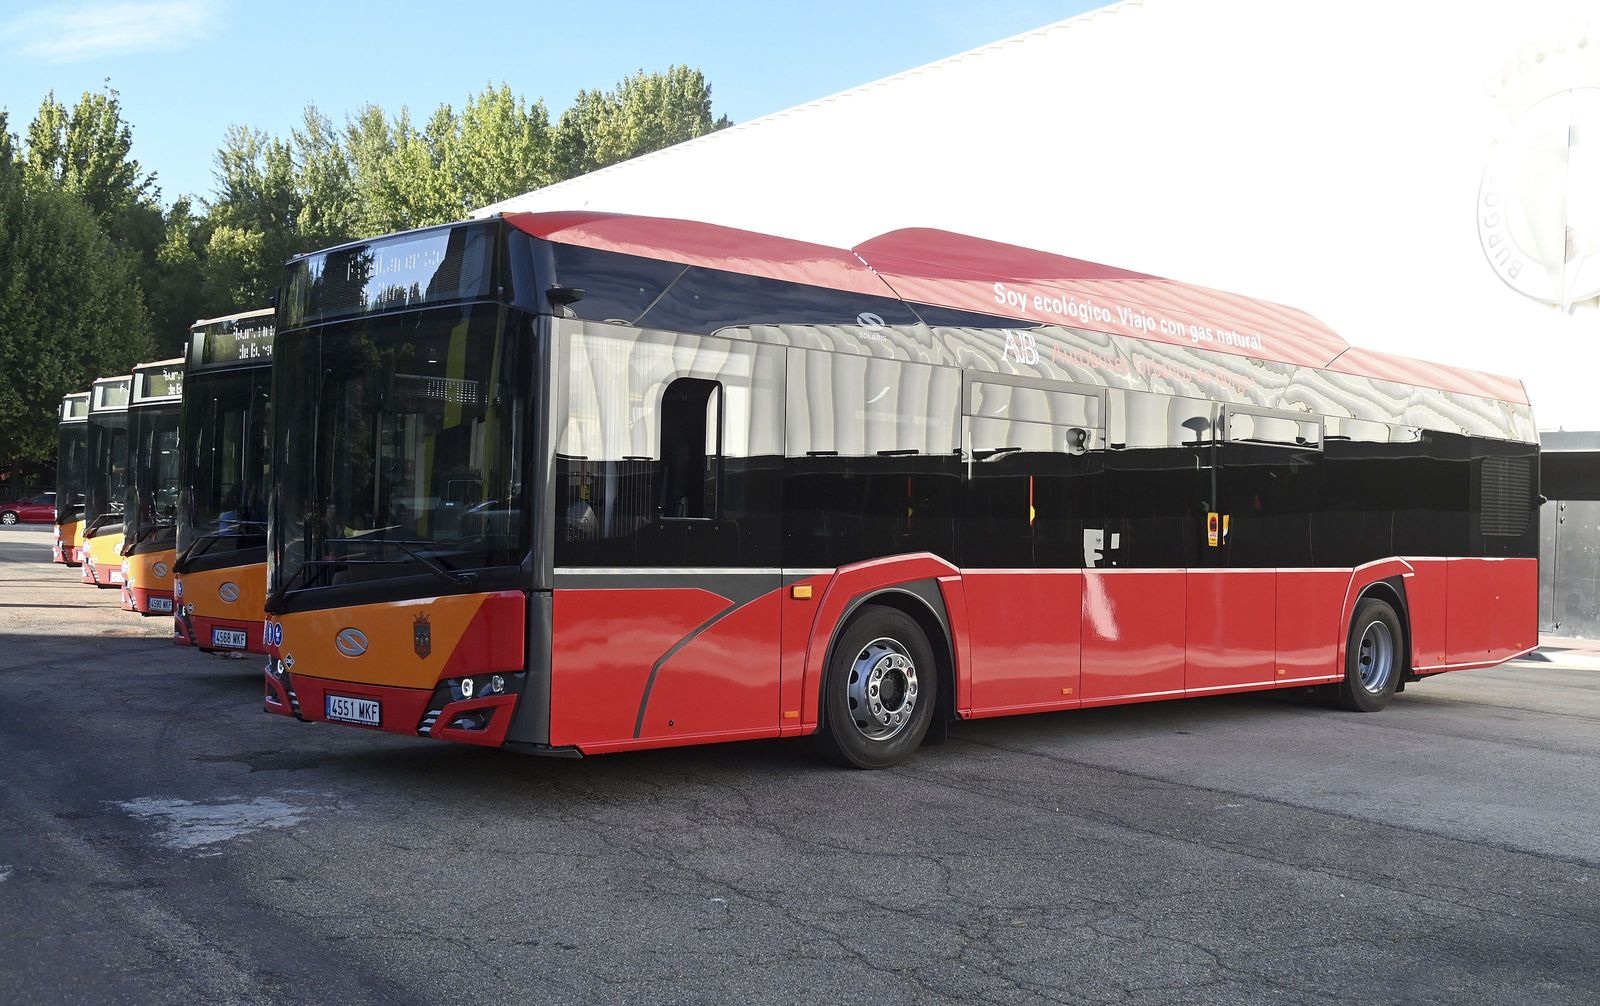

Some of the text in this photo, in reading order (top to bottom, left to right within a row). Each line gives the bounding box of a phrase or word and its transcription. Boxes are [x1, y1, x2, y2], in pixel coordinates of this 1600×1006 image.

[994, 282, 1265, 351] Soy ecológico. Viajo con gas natural.
[332, 699, 378, 720] 4551 MKF
